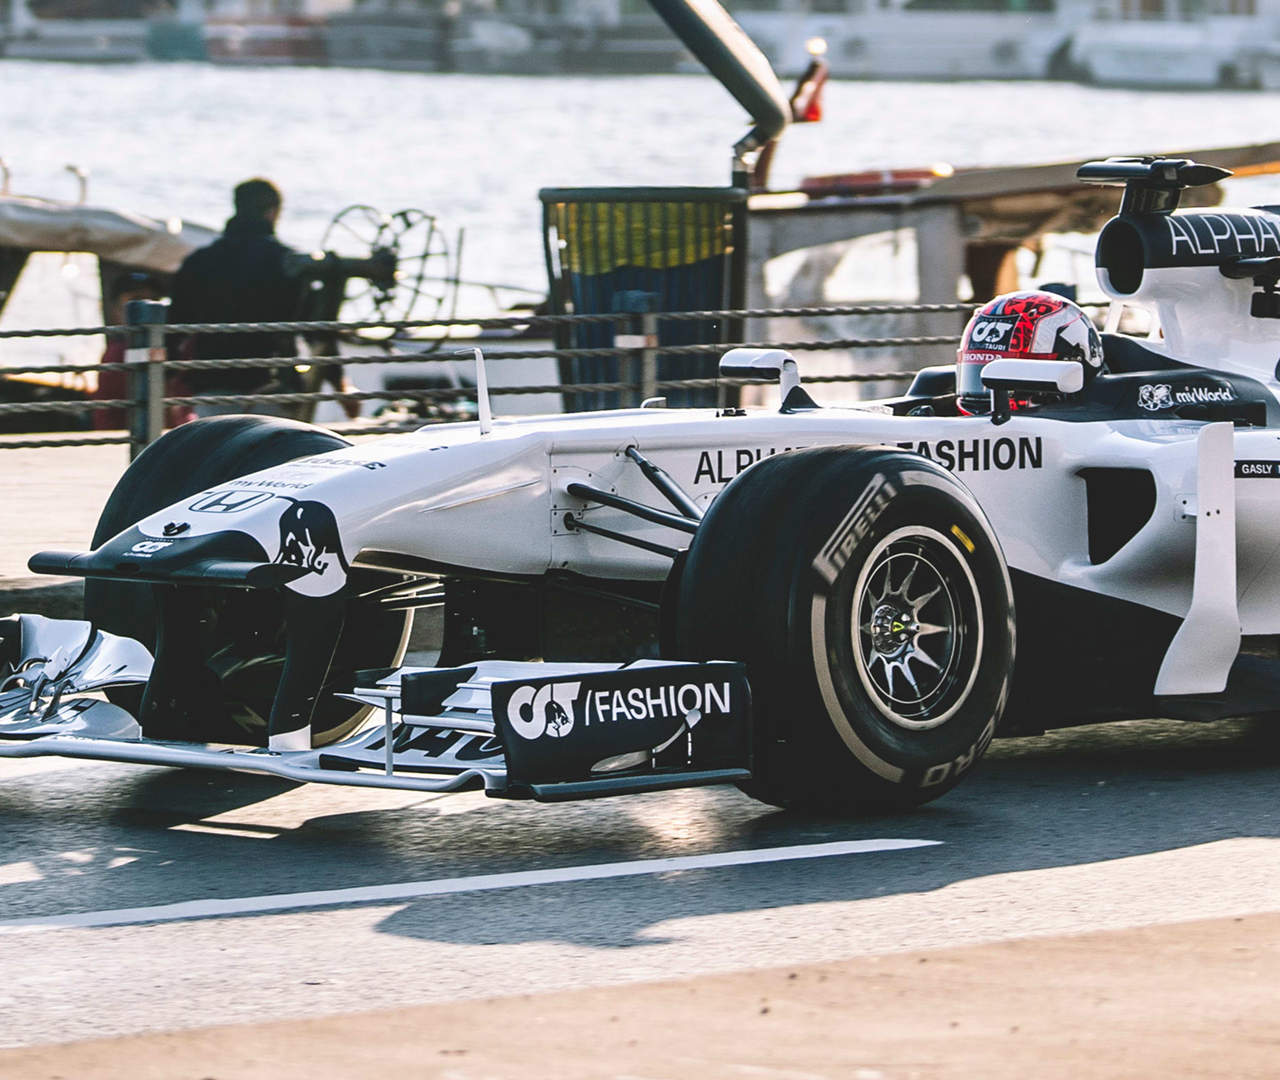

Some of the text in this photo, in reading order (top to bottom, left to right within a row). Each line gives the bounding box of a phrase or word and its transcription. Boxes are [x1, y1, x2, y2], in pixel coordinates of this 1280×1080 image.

[897, 436, 1042, 472] ASHION
[1241, 464, 1272, 474] GASLY
[812, 473, 898, 585] PIRELLI
